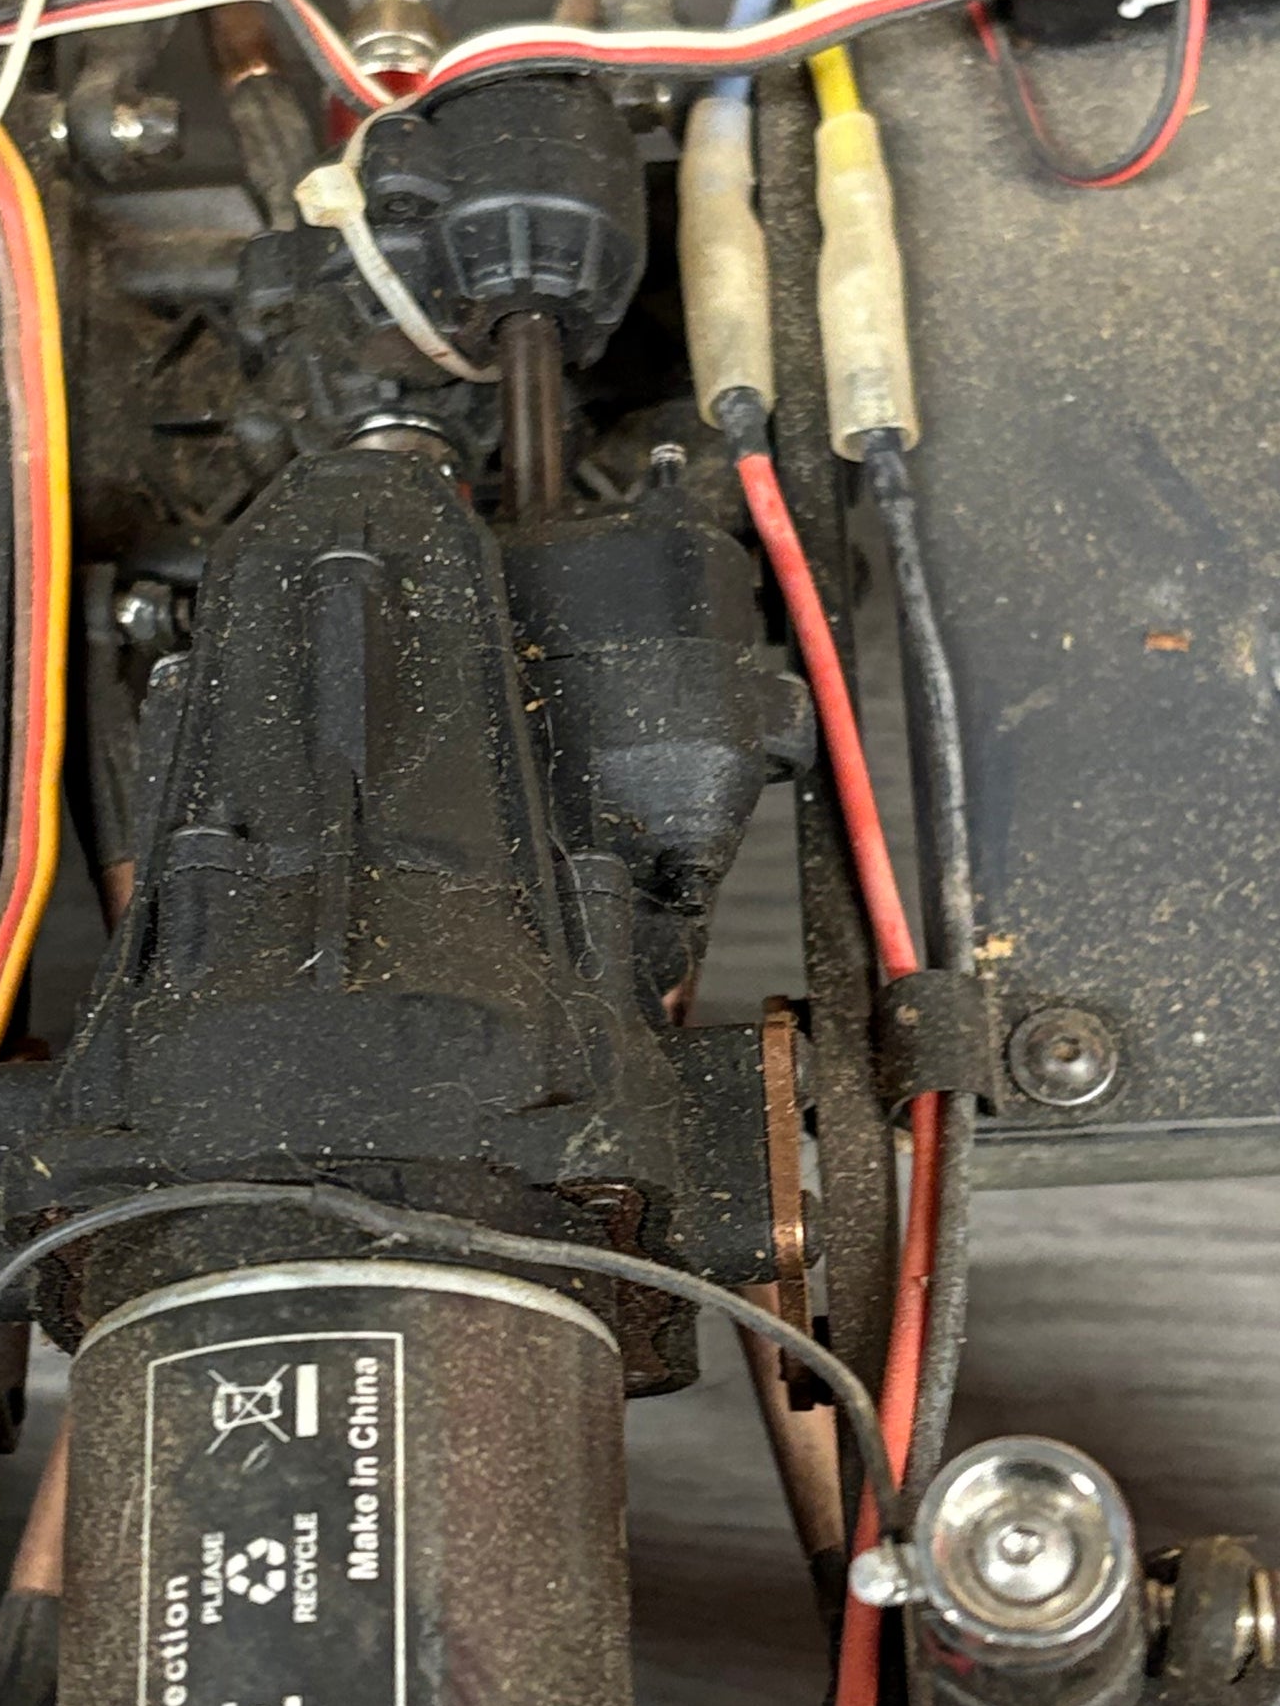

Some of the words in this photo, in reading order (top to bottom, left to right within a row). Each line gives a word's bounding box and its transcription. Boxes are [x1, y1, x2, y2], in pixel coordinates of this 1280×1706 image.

[347, 1356, 380, 1450] China
[200, 1531, 224, 1625] PLEASE
[293, 1512, 319, 1624] RECYCLE
[346, 1492, 380, 1580] Make
